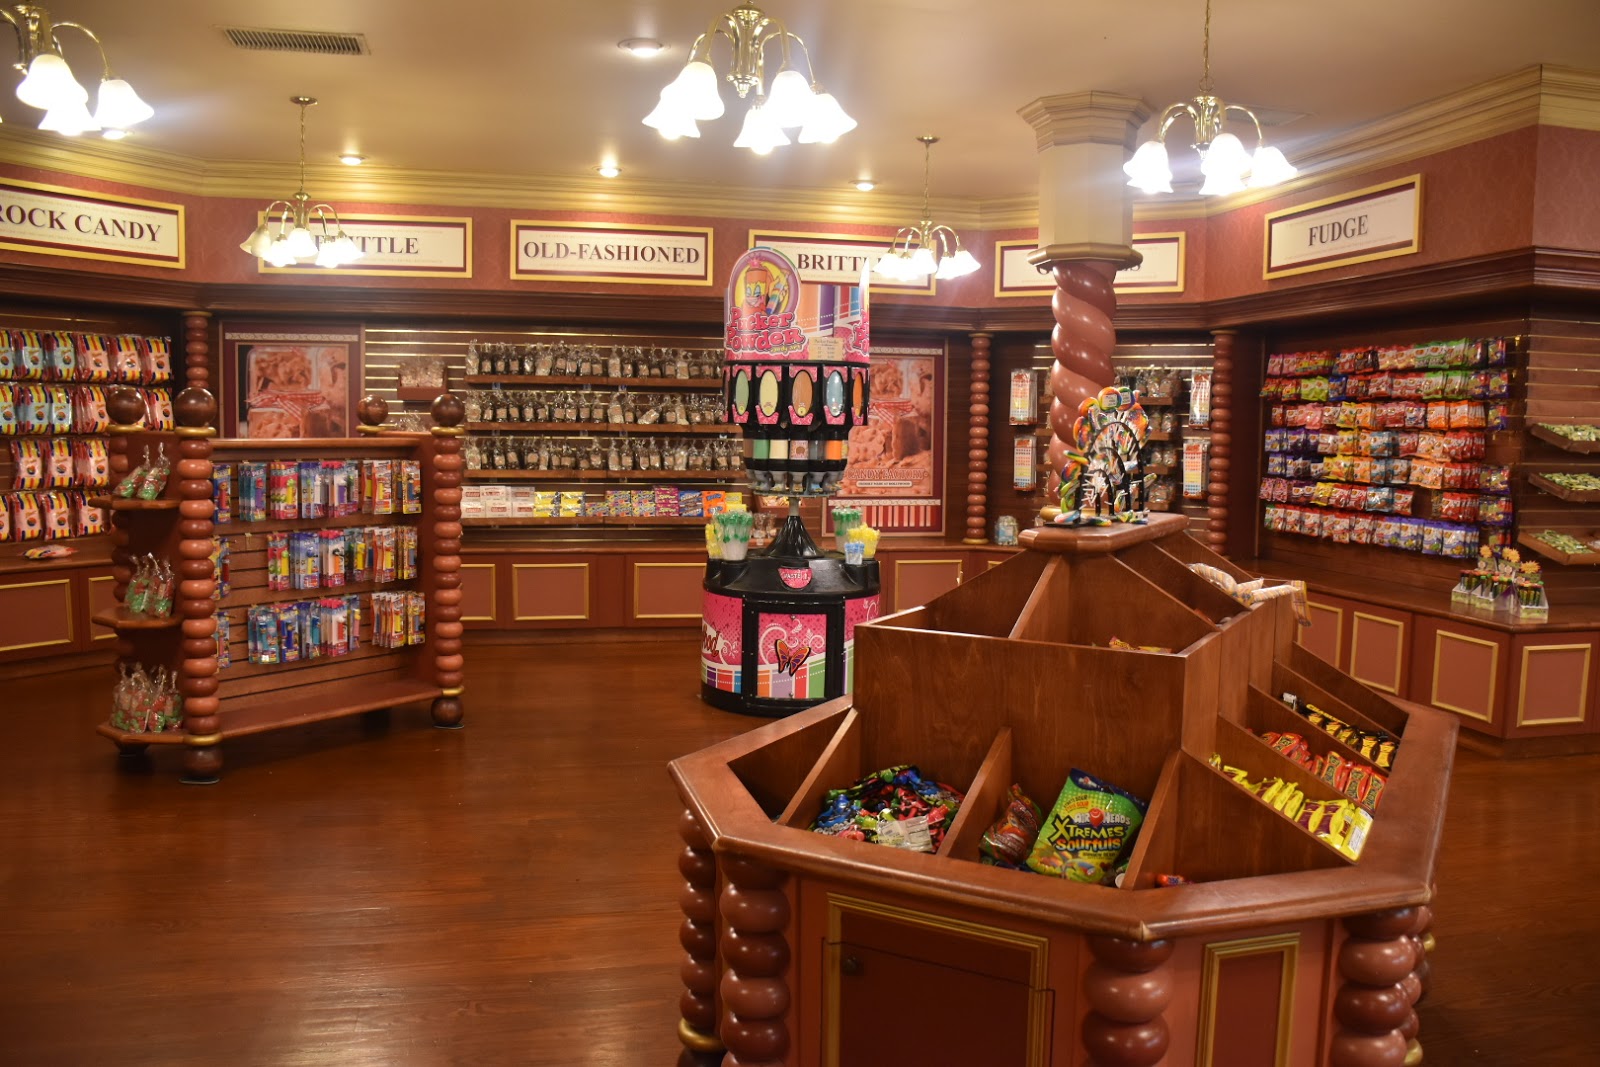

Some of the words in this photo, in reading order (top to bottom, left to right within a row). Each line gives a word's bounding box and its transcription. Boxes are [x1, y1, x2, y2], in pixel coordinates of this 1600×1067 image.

[0, 204, 66, 230] OCK
[75, 214, 161, 242] CANDY
[1308, 214, 1368, 246] FUDGE
[523, 241, 700, 264] OLD-FASHIONED
[797, 253, 882, 272] BRITT
[848, 468, 881, 480] CANDY
[881, 468, 924, 480] FACTORY
[1050, 818, 1124, 841] XTREMES
